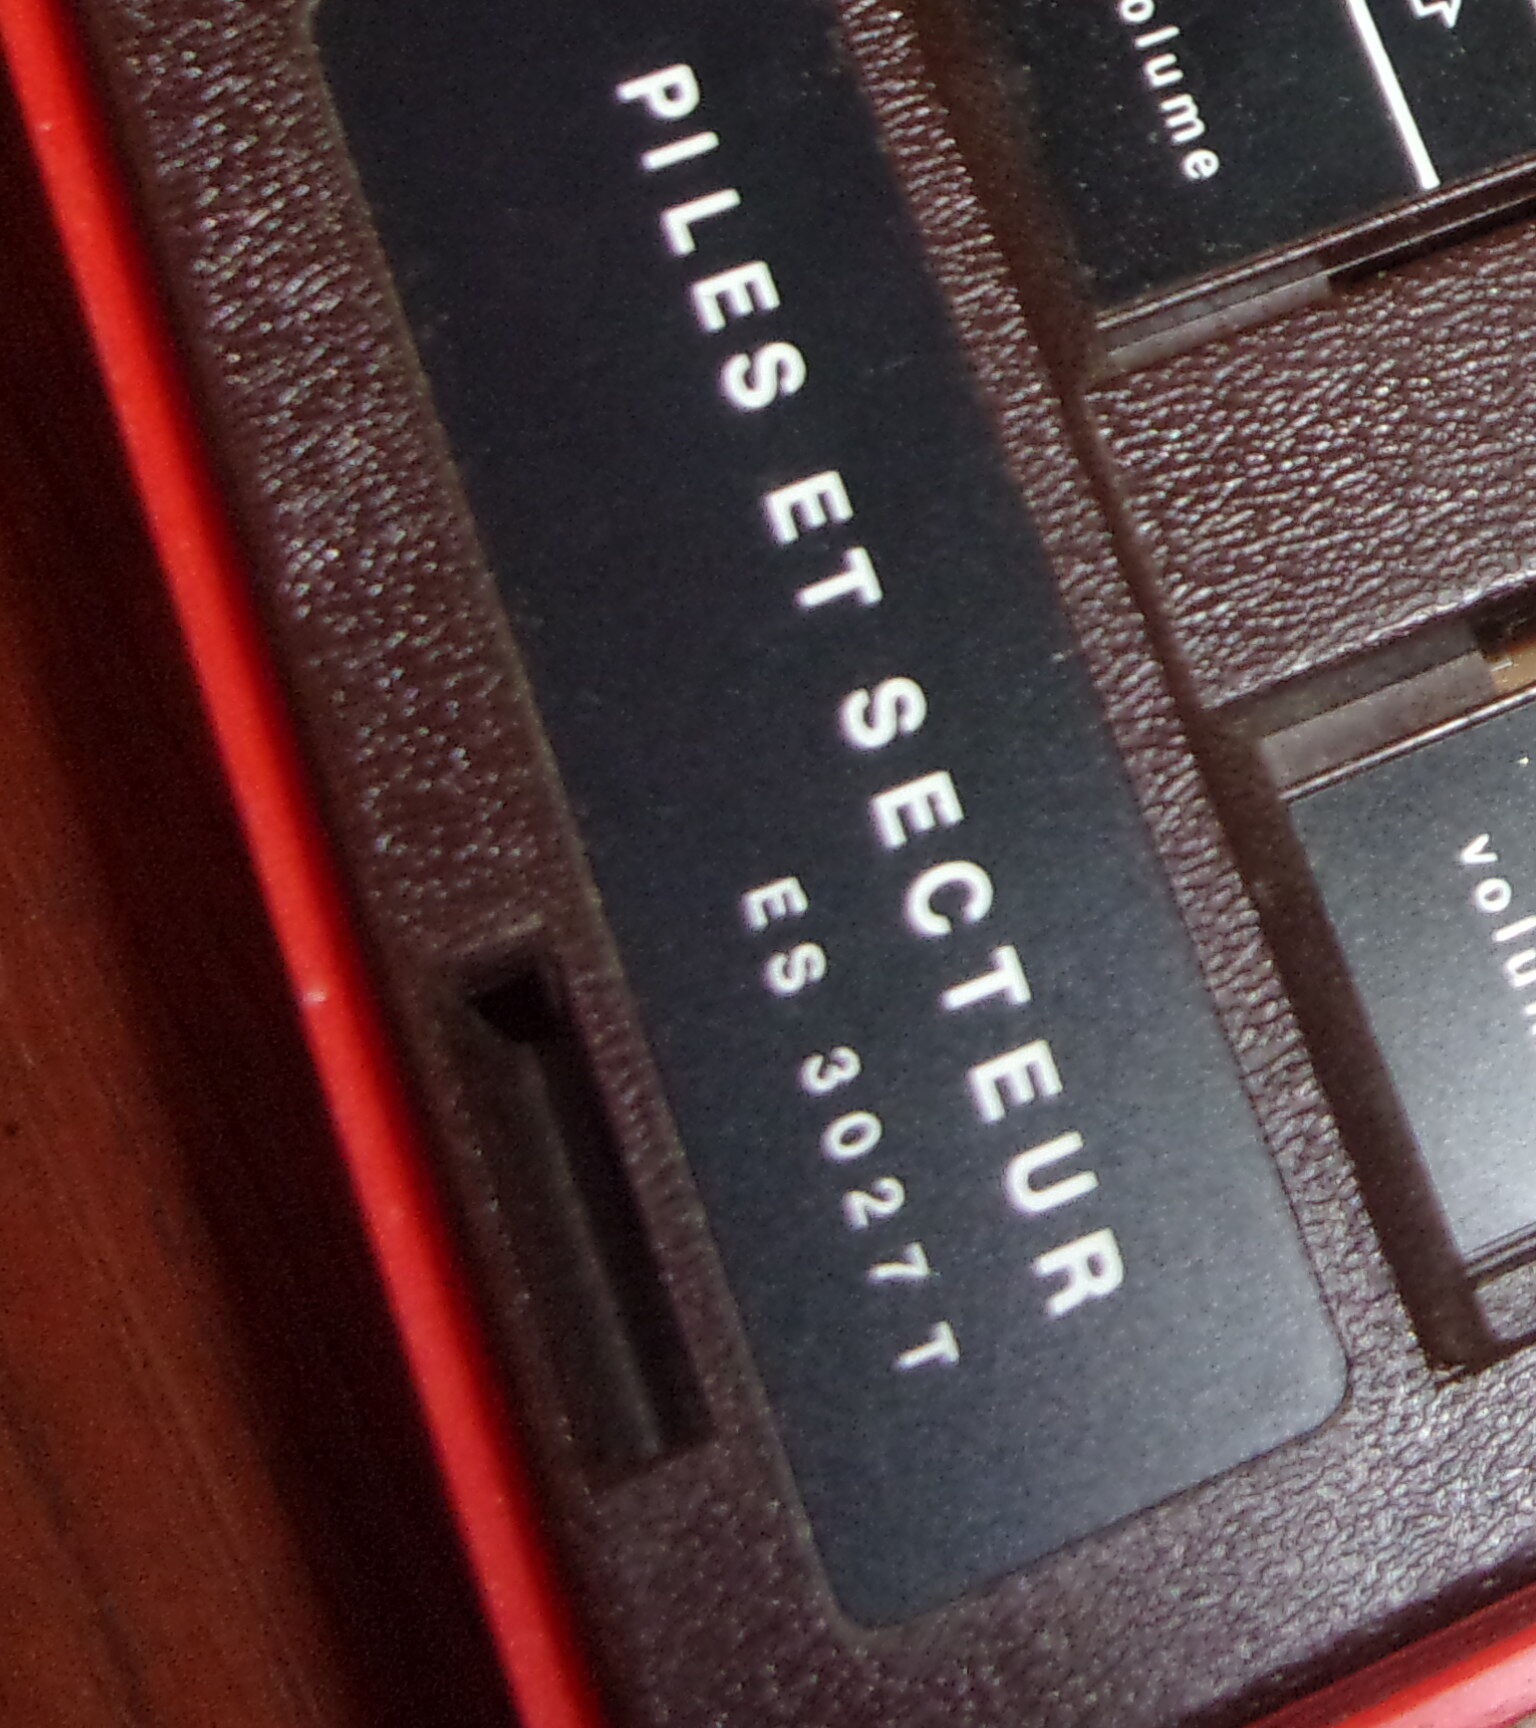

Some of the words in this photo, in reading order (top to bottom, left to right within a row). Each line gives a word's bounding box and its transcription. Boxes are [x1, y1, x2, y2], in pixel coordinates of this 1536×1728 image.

[615, 62, 808, 413] PILES
[762, 469, 884, 611] ET
[839, 674, 1127, 1320] SECTEUR
[740, 875, 829, 997] ES
[798, 1045, 933, 1284] 3027
[895, 1319, 962, 1372] T
